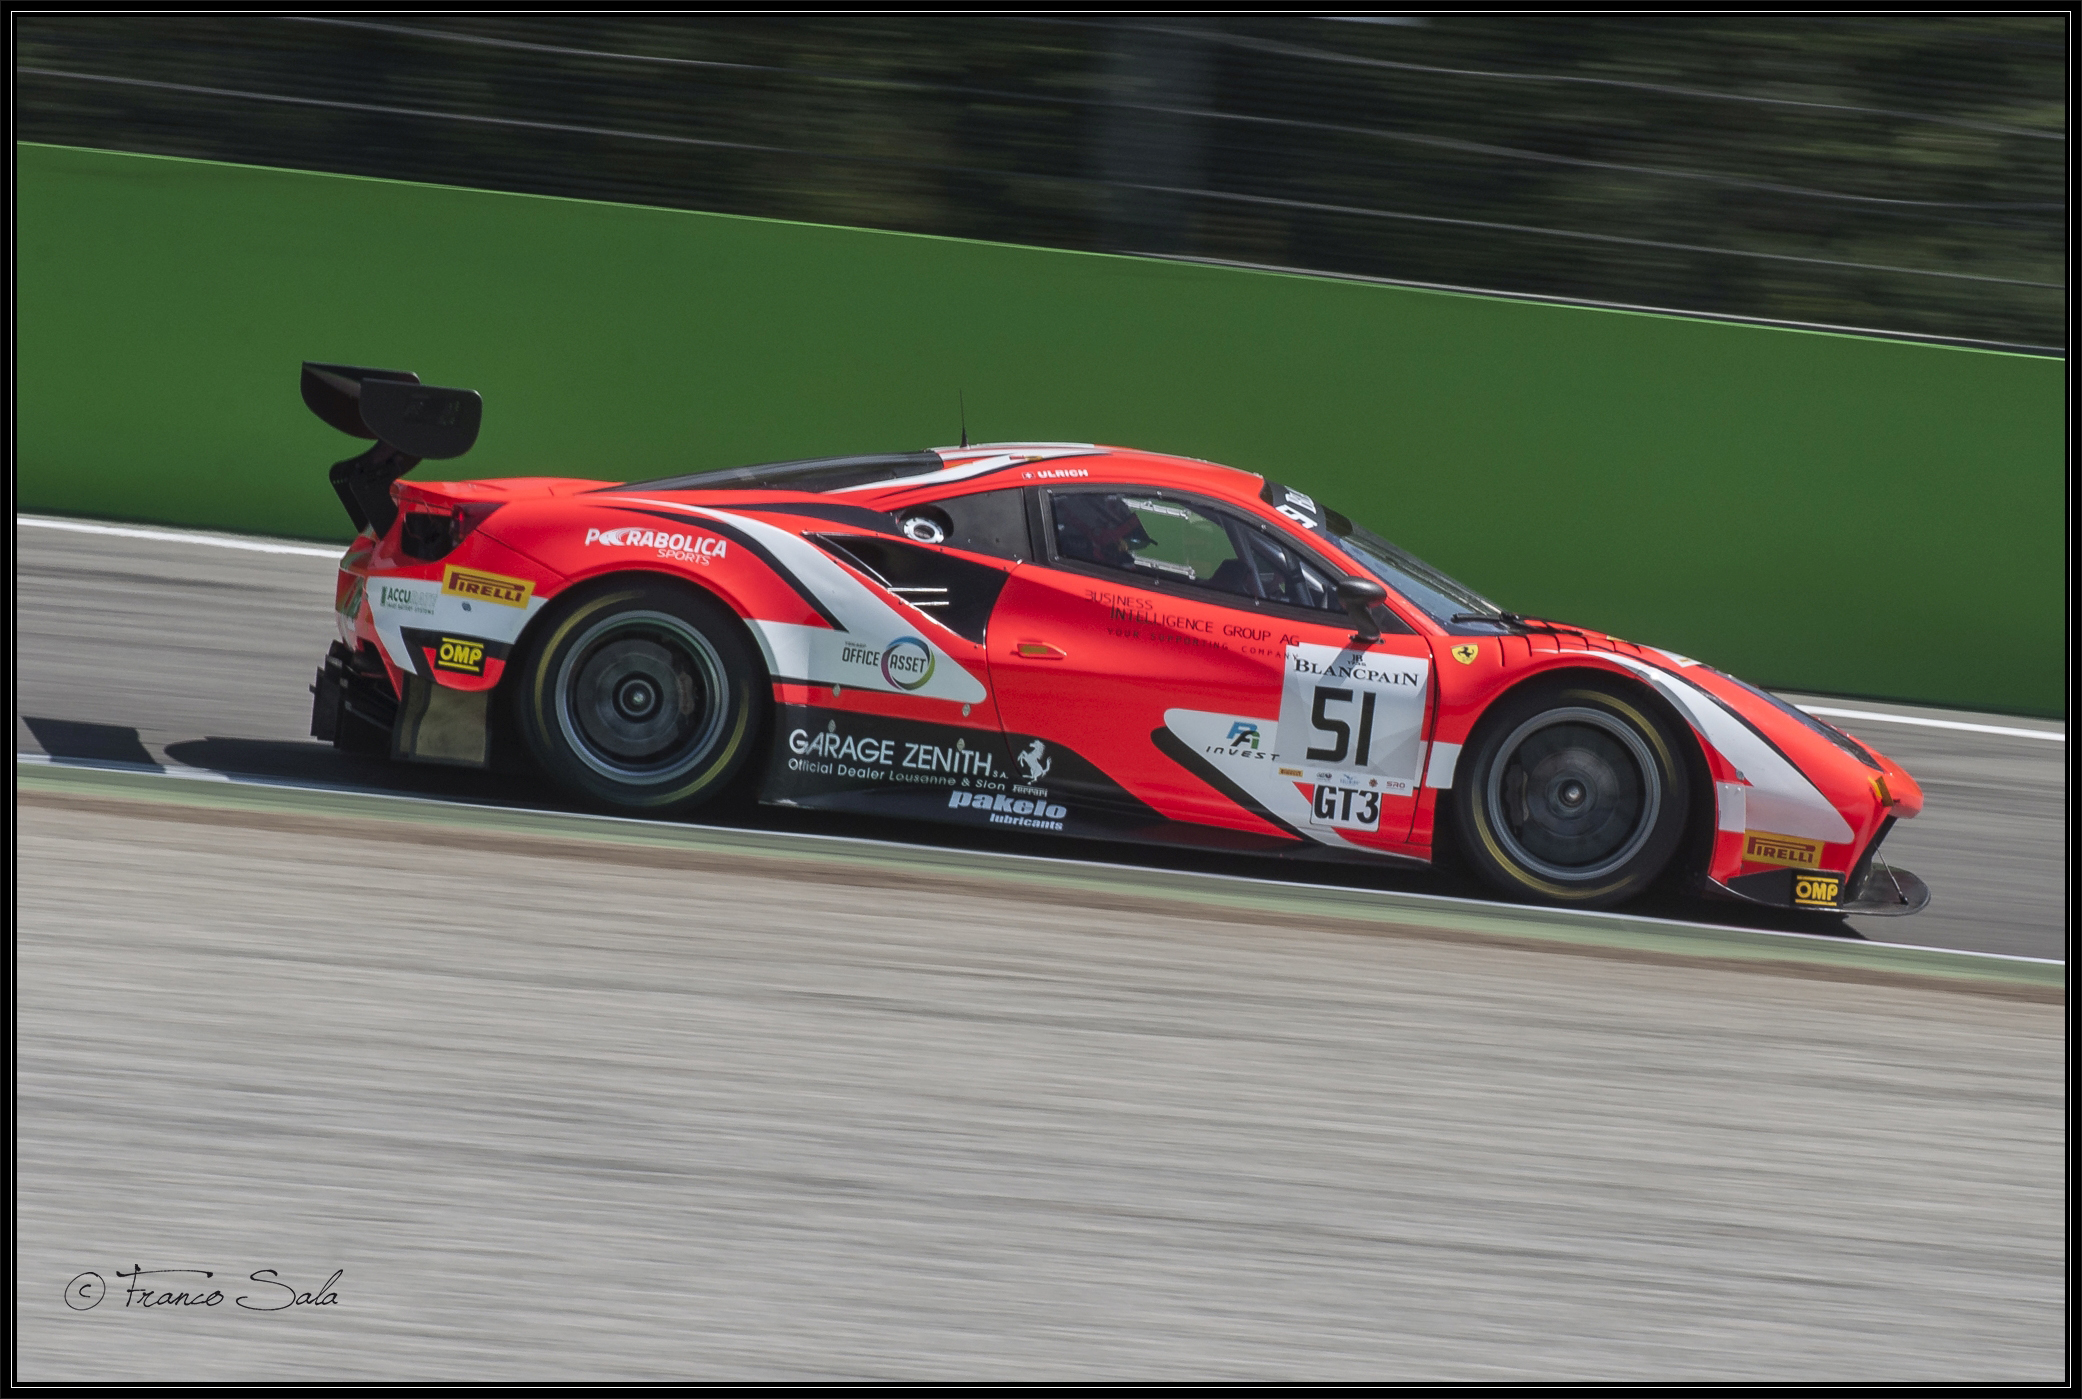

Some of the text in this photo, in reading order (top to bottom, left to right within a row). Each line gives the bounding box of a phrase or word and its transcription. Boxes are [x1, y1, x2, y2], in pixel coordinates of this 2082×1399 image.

[1036, 469, 1089, 479] ULRICH
[656, 548, 711, 567] SPORTS
[448, 571, 526, 603] PIRELLI
[1110, 606, 1299, 647] INTELLIGENCE GROUP AG
[439, 643, 483, 666] OMP
[1107, 627, 1299, 661] YOUR SUPPORTING COMPANY
[842, 647, 927, 674] OFFICE ASSET
[1294, 658, 1419, 688] BLANCPAIN
[1306, 685, 1377, 768] 51
[788, 728, 896, 765] GARAGE
[788, 757, 833, 775] Official
[837, 763, 885, 780] Dealer
[960, 777, 971, 788] &
[974, 779, 1006, 791] Sion
[1386, 780, 1406, 790] SRO
[948, 789, 1068, 820] pakelo
[1012, 783, 1049, 798] Ferrari
[1313, 784, 1380, 825] GT3
[989, 812, 1064, 832] lubricants
[1746, 835, 1817, 864] PIRELLI
[1795, 880, 1839, 901] OMP
